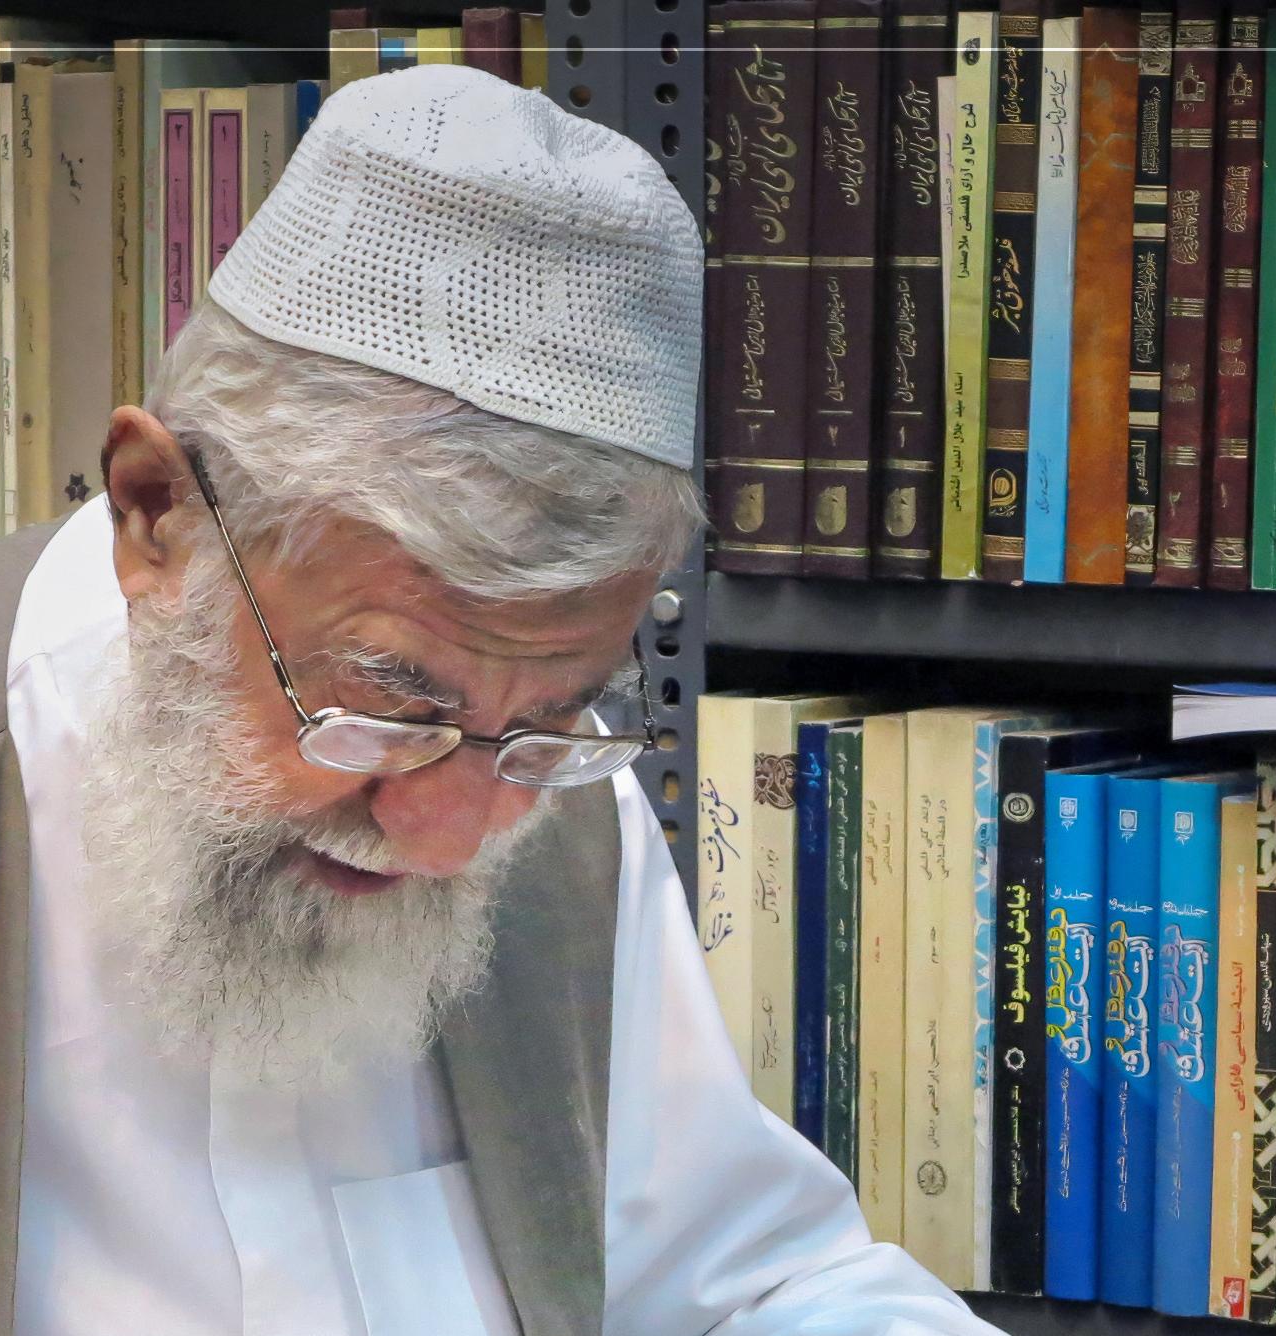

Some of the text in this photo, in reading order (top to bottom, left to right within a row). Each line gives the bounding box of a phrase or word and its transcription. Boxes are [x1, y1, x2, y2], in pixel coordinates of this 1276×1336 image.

[961, 104, 976, 128] شرح
[961, 133, 975, 154] حال
[958, 195, 972, 231] فلسفی
[1063, 889, 1093, 900] جلد
[1003, 885, 1031, 1023] نیایش فیلسوف
